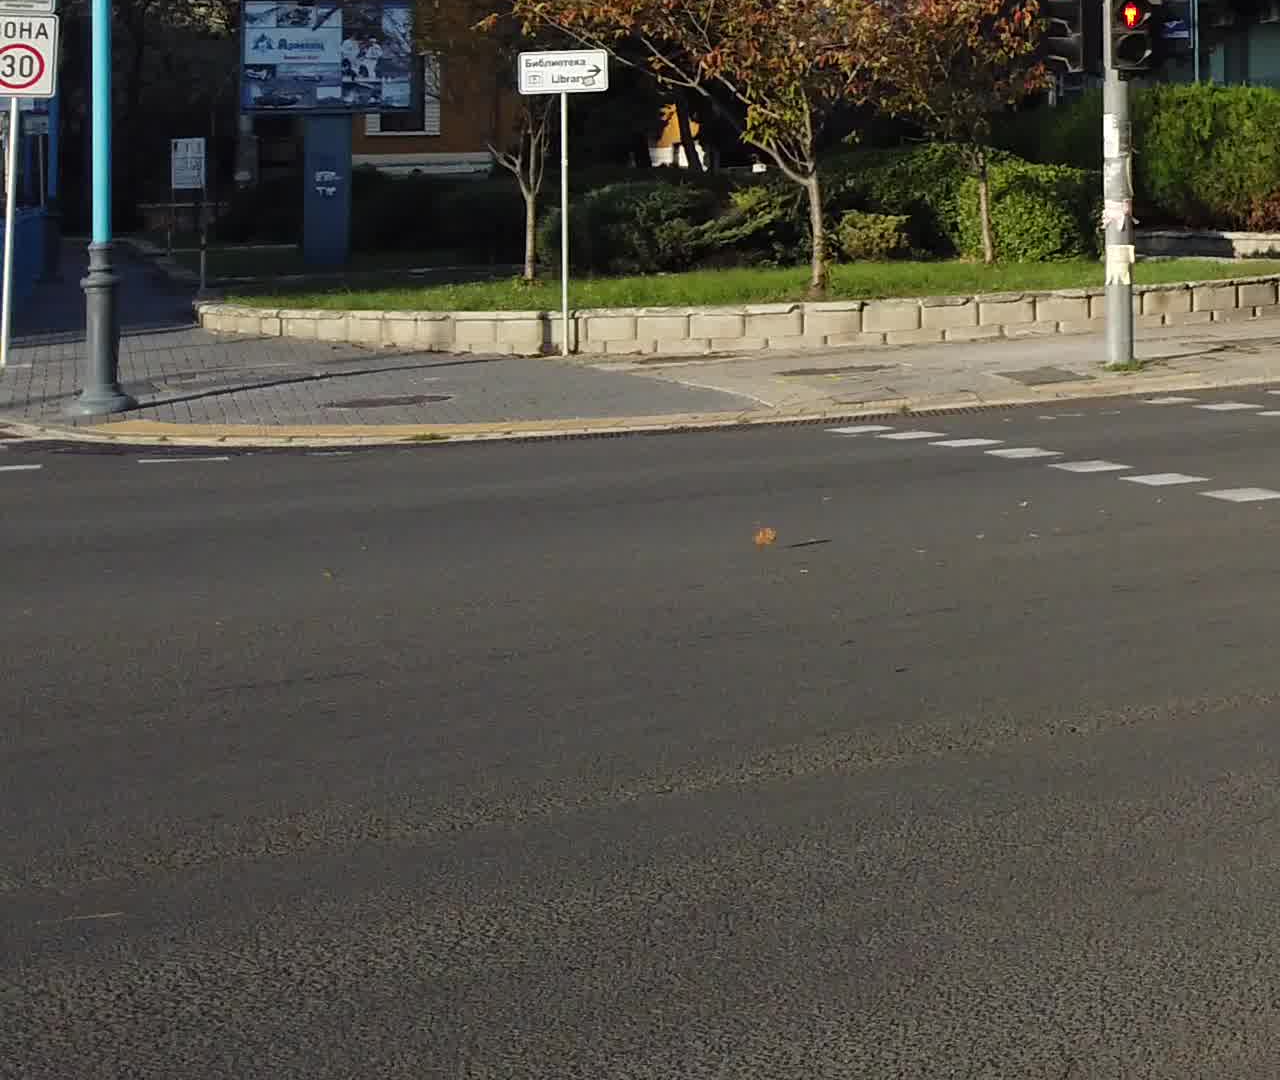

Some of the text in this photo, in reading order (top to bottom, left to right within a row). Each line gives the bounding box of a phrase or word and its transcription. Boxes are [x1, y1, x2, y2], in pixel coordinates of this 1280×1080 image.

[0, 22, 49, 40] ОНА
[2, 55, 34, 78] 30
[525, 58, 586, 68] Библиотека
